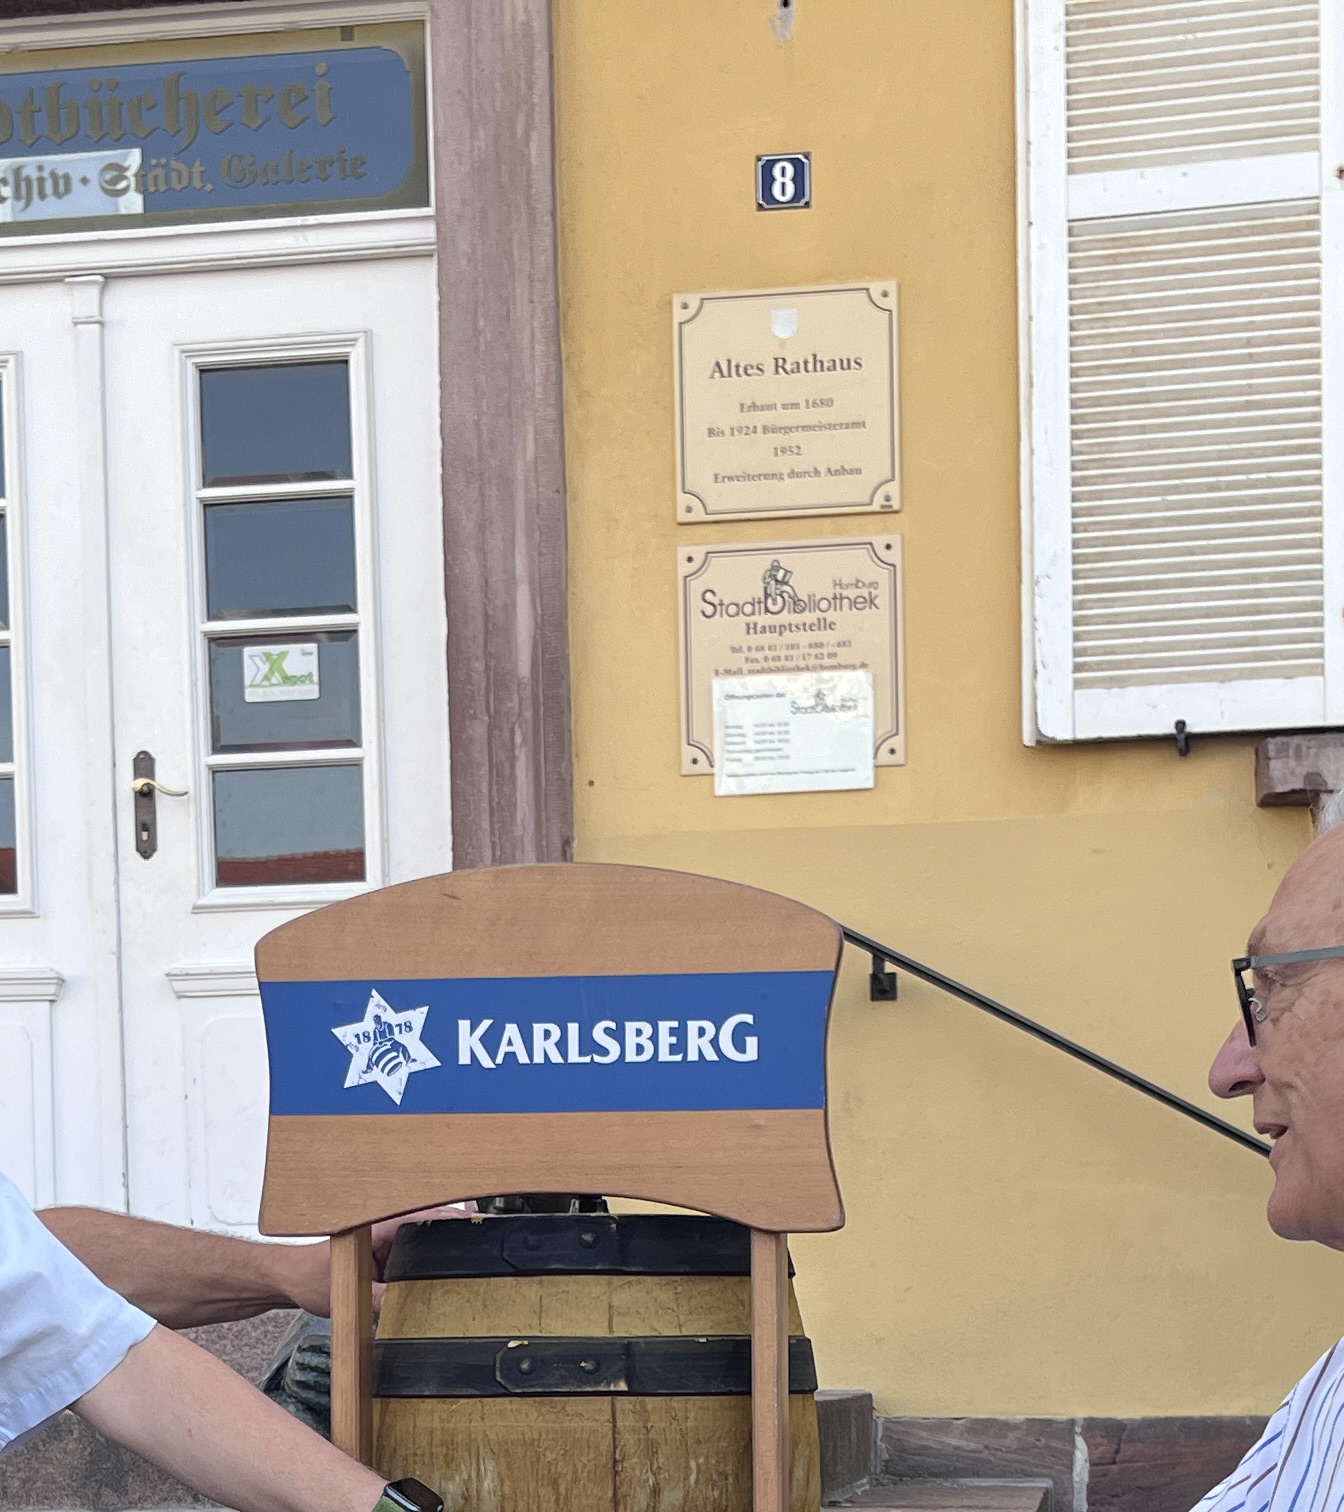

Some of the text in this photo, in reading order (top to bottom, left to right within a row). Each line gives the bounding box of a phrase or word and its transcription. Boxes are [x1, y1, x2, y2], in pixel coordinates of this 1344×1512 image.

[98, 157, 215, 199] Städt.
[219, 144, 368, 188] Galerie
[770, 160, 796, 203] 8
[709, 352, 864, 380] Altes Rathaus
[739, 401, 778, 414] Erbaut
[707, 426, 726, 438] Bis
[761, 419, 867, 437] Bürgermeisteramt
[772, 445, 803, 458] 1952
[713, 471, 785, 484] Erweiterung
[787, 467, 822, 480] durch
[744, 616, 838, 637] Hauptstelle
[354, 1020, 414, 1045] 18 78
[456, 1013, 759, 1069] KARLSBERG
